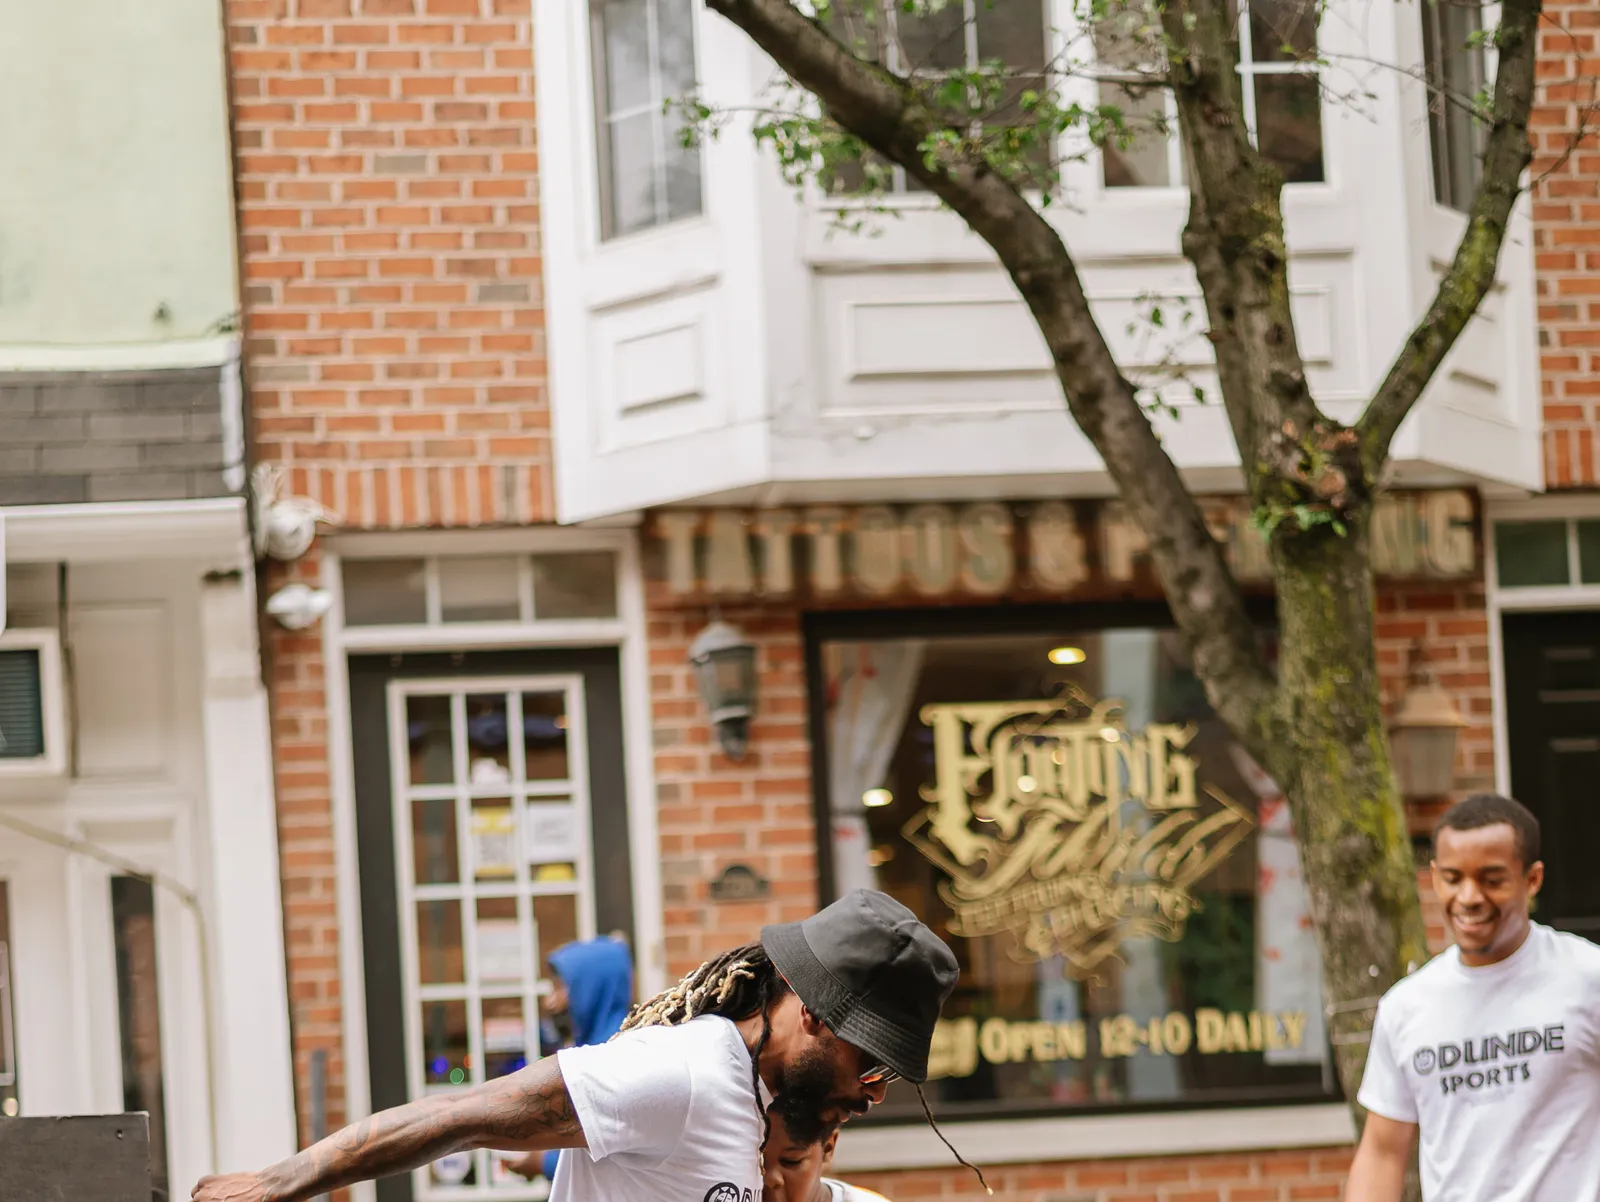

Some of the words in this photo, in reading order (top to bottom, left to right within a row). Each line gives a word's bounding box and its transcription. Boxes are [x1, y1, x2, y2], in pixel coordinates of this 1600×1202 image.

[659, 505, 1013, 596] TATTOOS
[979, 1017, 1087, 1064] OPEN
[1196, 1006, 1307, 1055] DAILY
[1440, 1062, 1531, 1095] SPORTS
